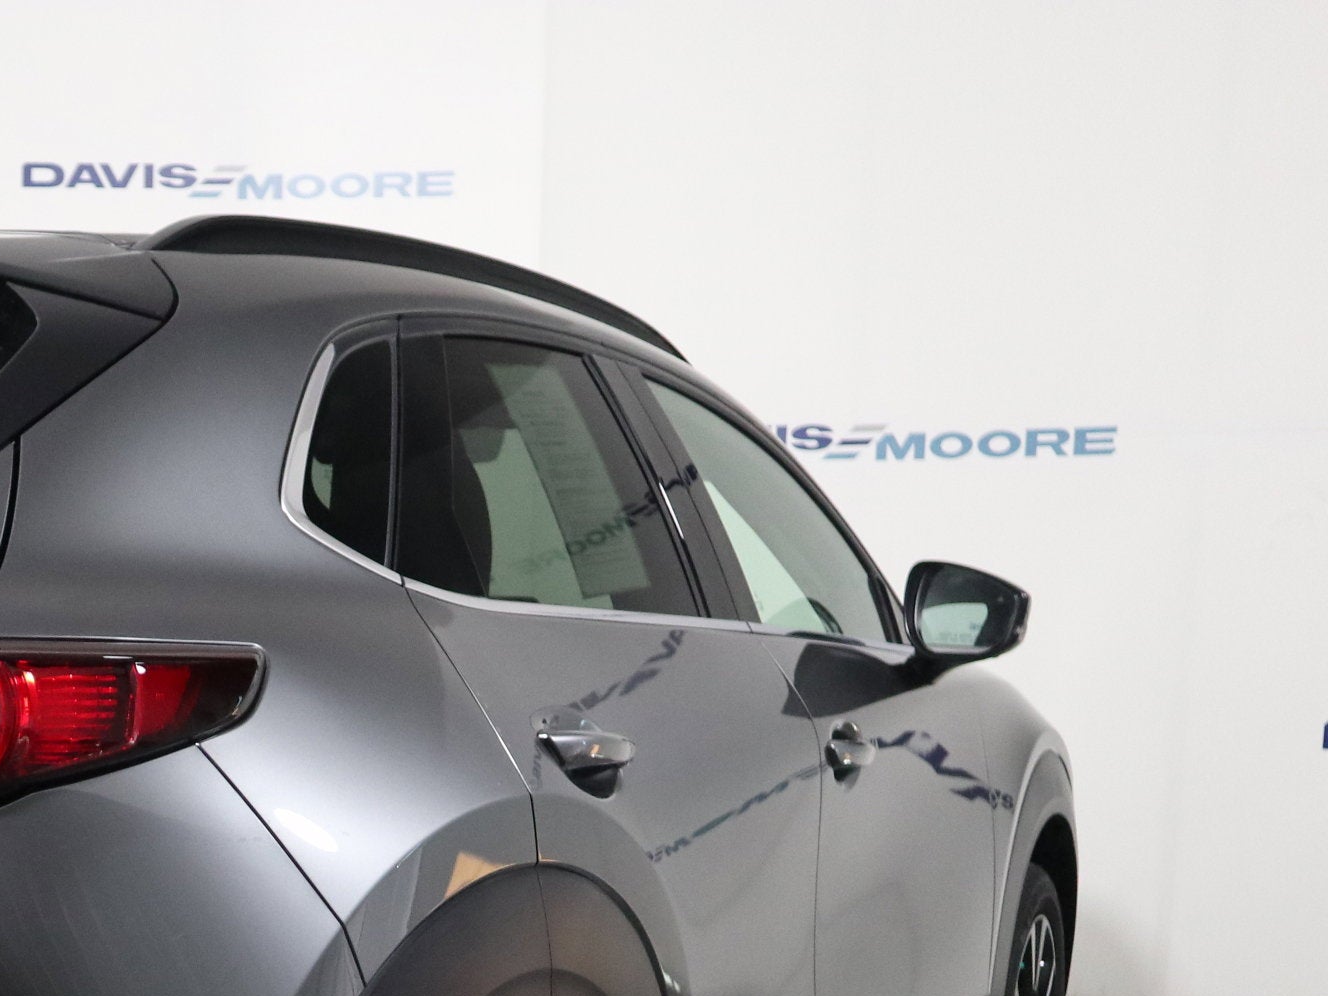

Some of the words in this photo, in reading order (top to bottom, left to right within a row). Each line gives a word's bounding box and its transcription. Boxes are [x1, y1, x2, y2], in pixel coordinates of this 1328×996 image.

[22, 162, 196, 189] DAVIS
[237, 170, 455, 200] MOORE
[875, 425, 1118, 460] MOORE
